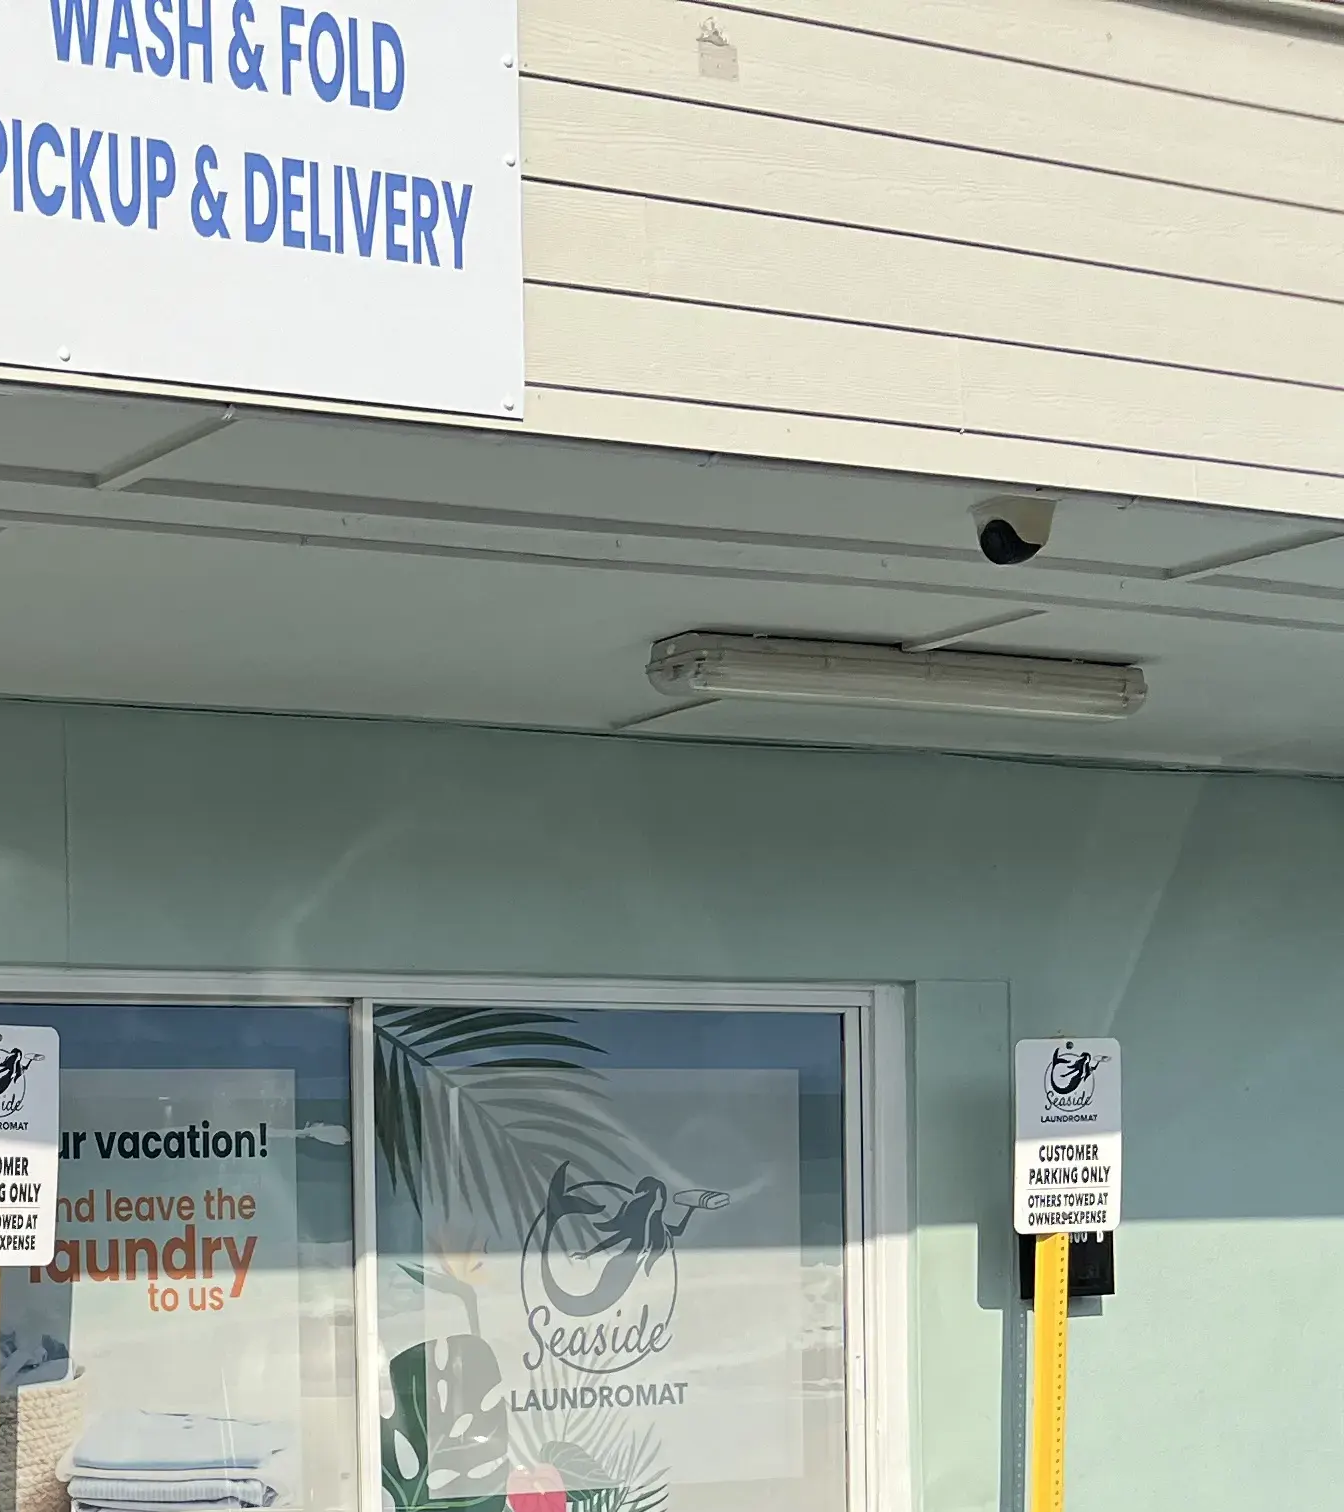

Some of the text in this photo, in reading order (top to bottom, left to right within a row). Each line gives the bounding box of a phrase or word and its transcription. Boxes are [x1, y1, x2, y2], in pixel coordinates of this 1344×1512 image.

[50, 0, 406, 111] WASH & FOLD
[191, 144, 230, 239] &
[245, 152, 473, 270] DELIVERY
[1044, 1091, 1093, 1110] Seaside
[1041, 1114, 1098, 1123] LAUNDROMAT
[95, 1120, 268, 1160] vacation!
[1039, 1144, 1099, 1162] CUSTOMER
[1029, 1165, 1111, 1185] PARKING ONLY
[10, 1183, 42, 1203] ONLY
[1027, 1192, 1109, 1208] OTHERS TOWED AT
[55, 1188, 256, 1224] nd leave the
[26, 1214, 38, 1230] AT
[1068, 1210, 1107, 1224] EXPENSE
[148, 1282, 224, 1312] to us
[523, 1304, 674, 1371] Seaside
[511, 1382, 689, 1412] LAUNDROMAT
